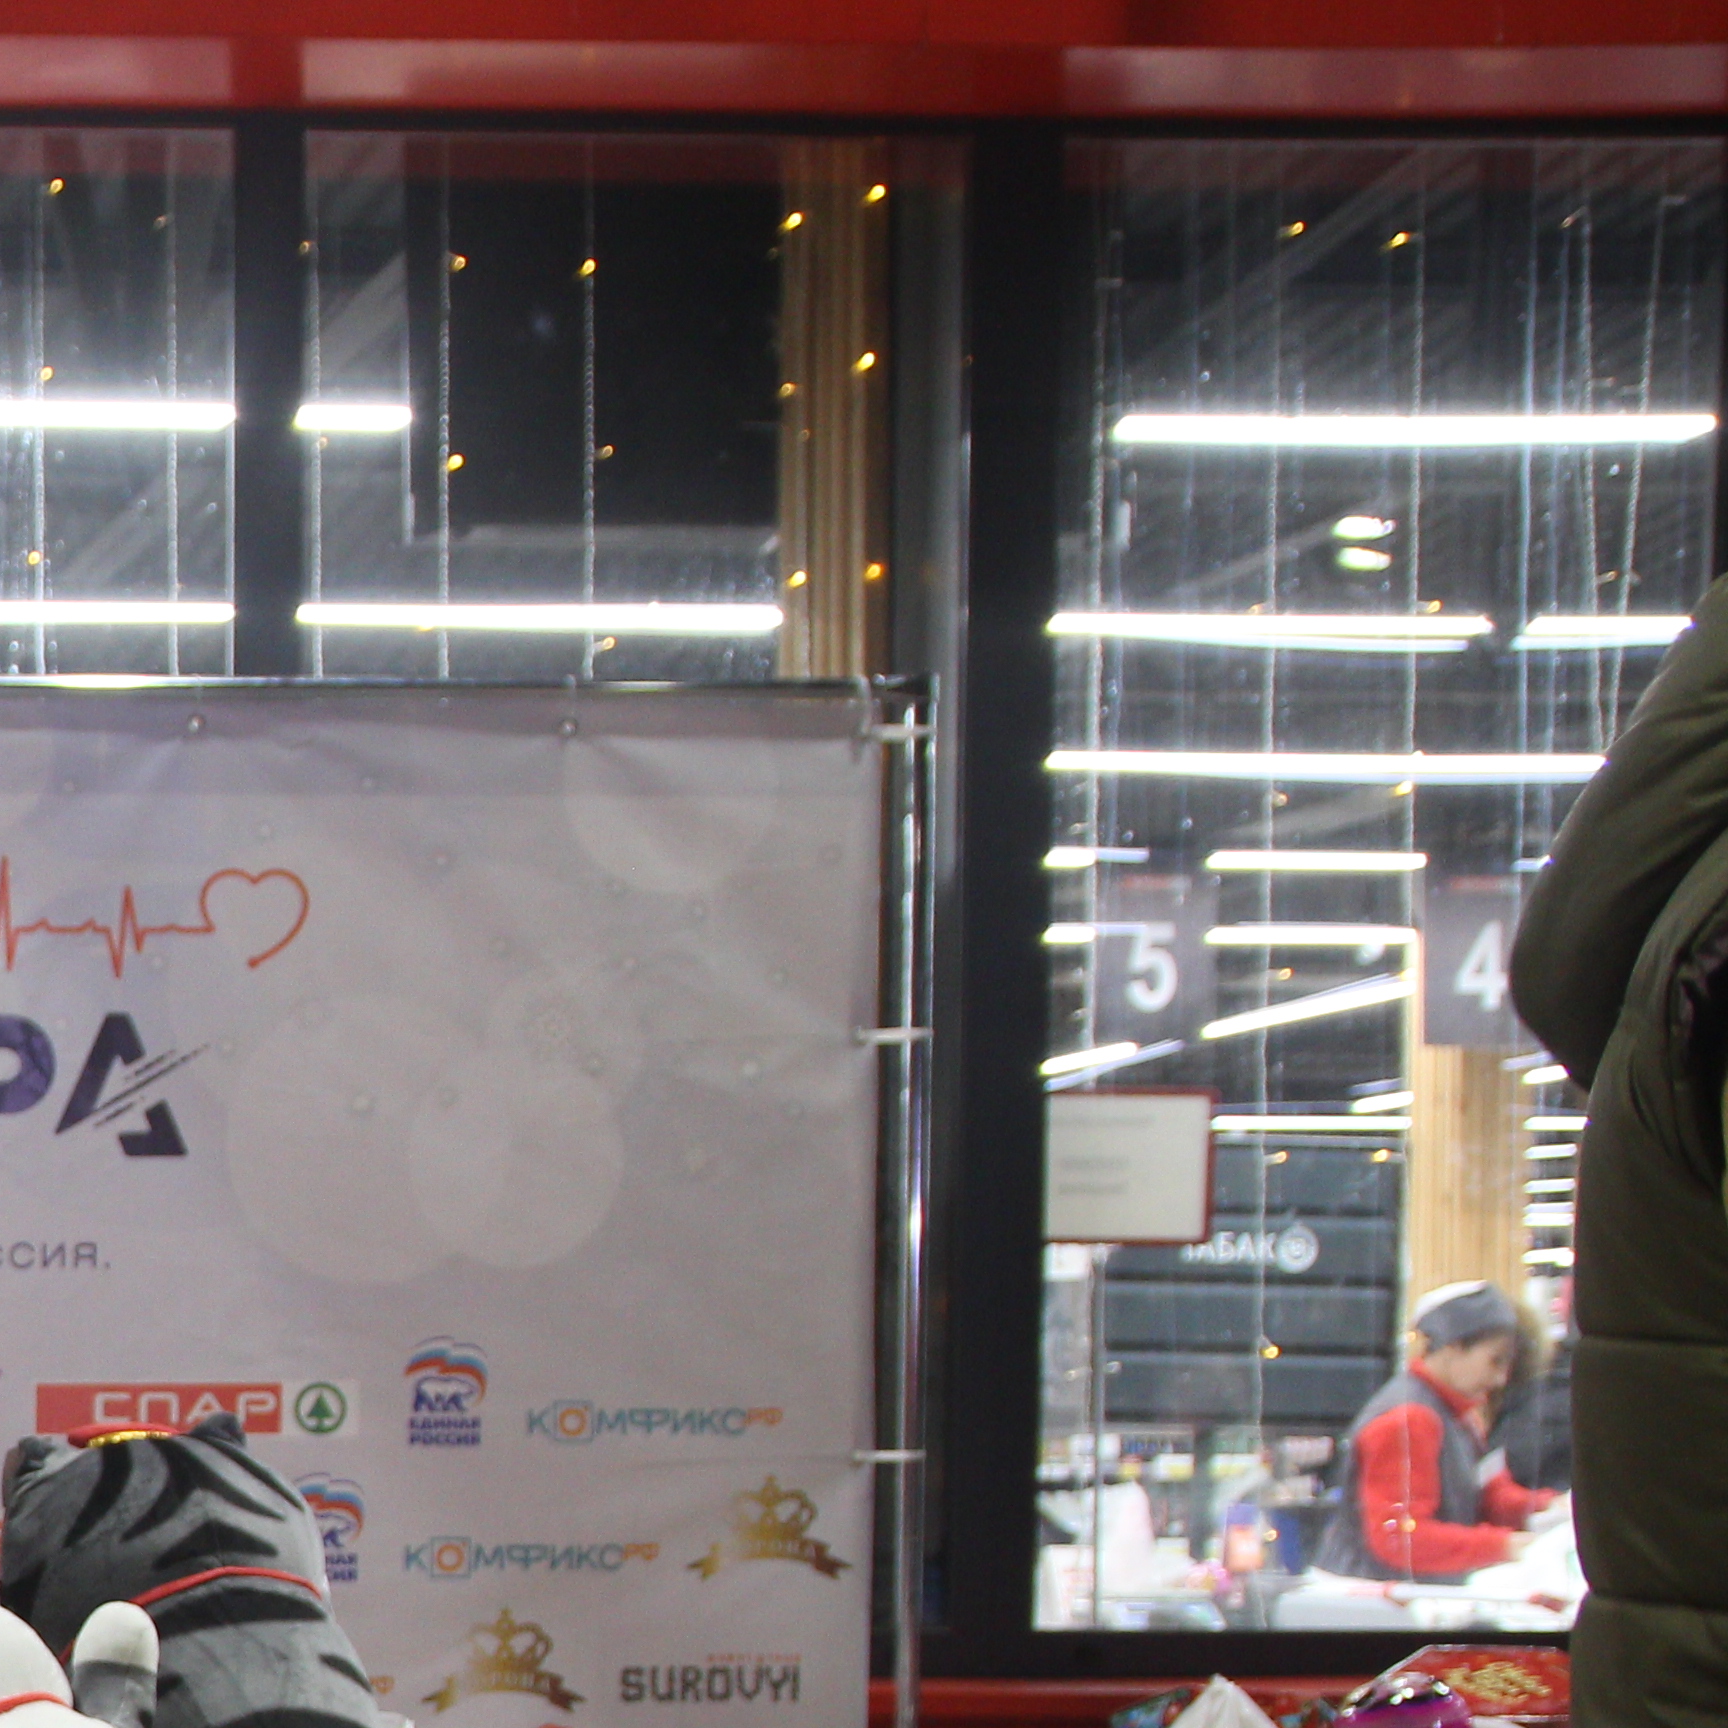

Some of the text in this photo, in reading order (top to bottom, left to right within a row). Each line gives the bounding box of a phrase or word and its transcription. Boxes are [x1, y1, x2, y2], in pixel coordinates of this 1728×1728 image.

[1124, 921, 1179, 1014] 5
[1454, 920, 1510, 1012] 4
[93, 1391, 277, 1425] СПАР
[619, 1665, 801, 1702] SUROVYI
